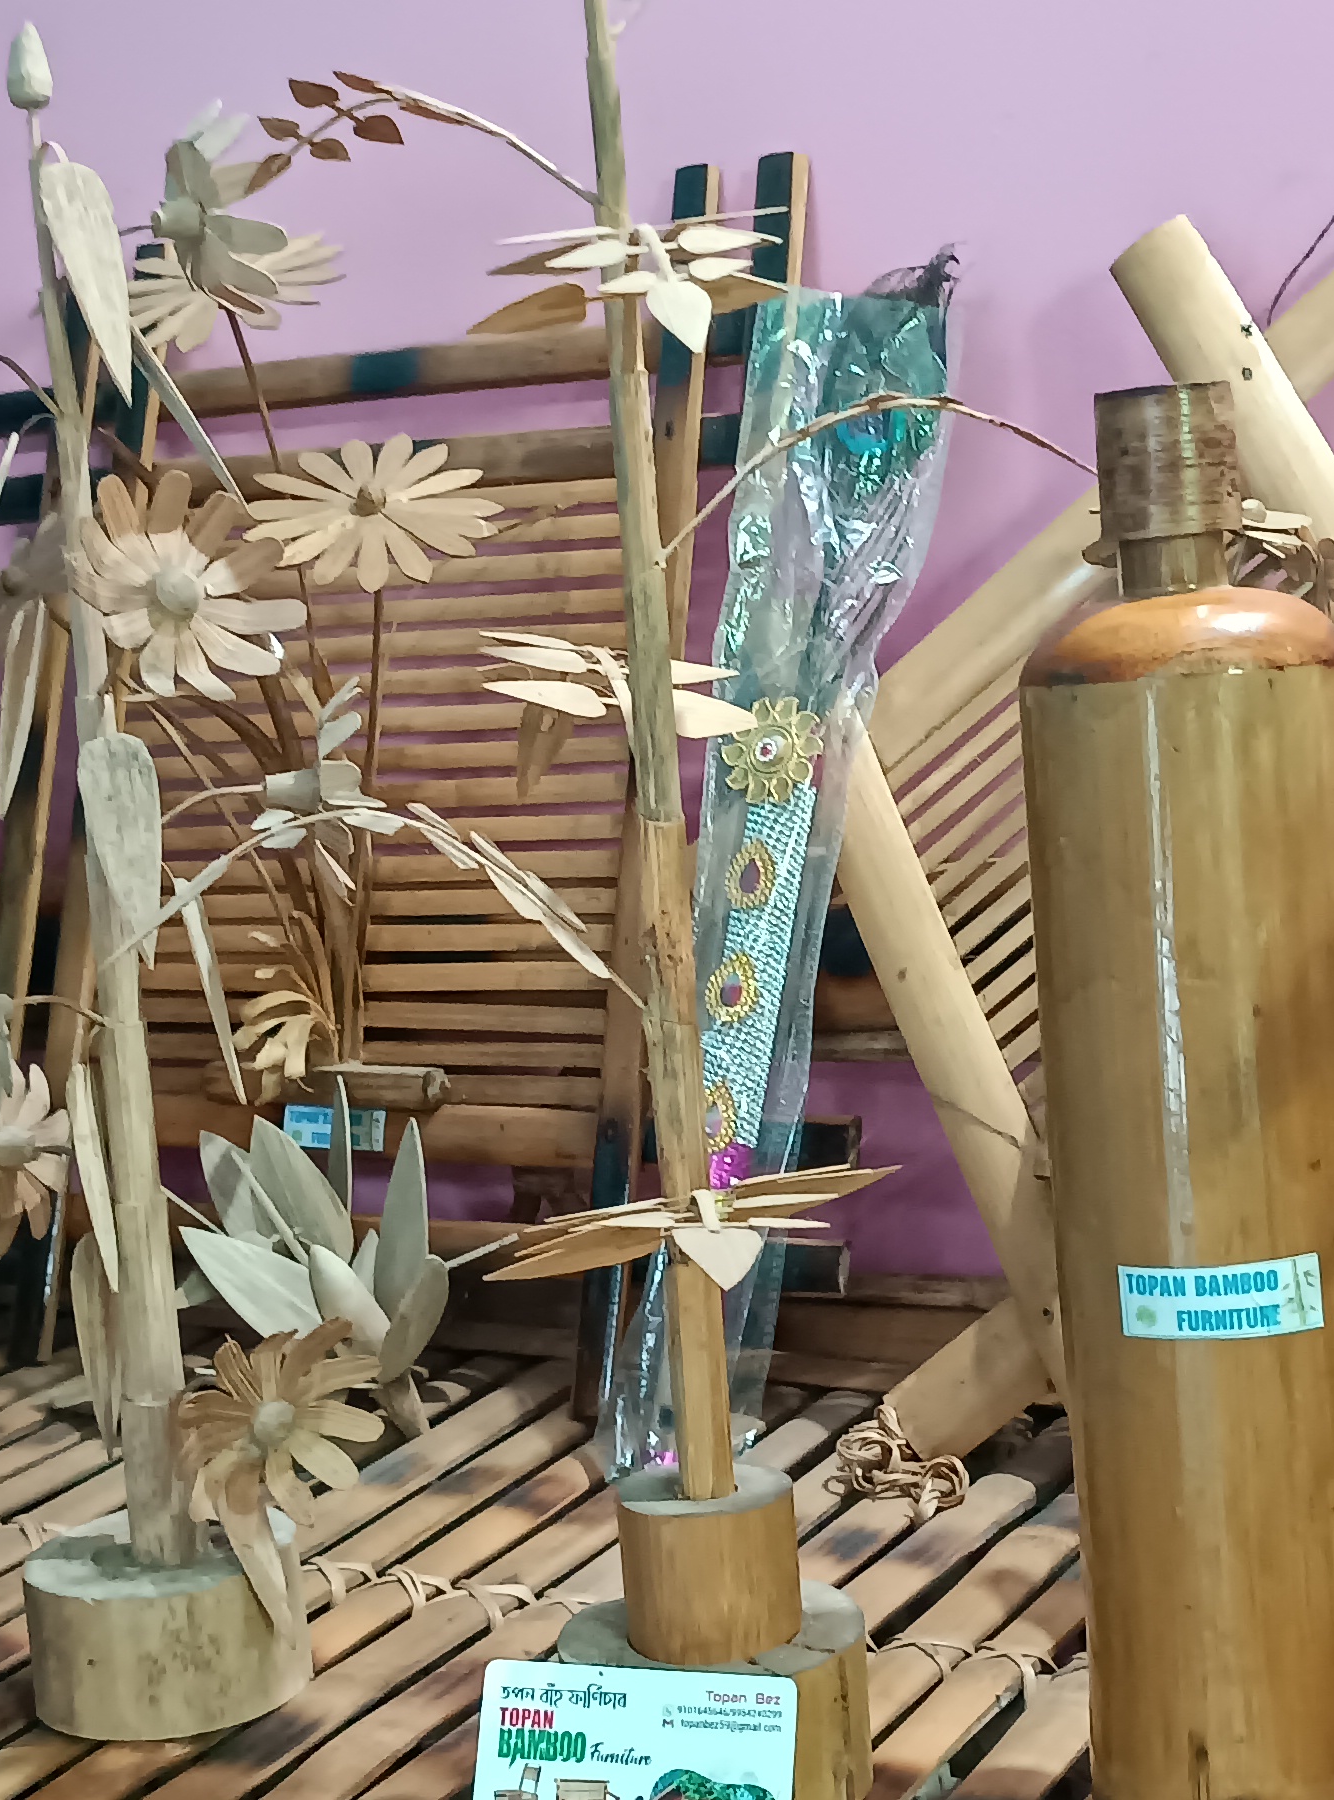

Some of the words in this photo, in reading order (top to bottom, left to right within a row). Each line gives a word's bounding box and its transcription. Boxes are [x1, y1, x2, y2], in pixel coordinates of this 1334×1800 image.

[1126, 1273, 1186, 1297] TOPAN
[1194, 1269, 1279, 1297] BAMBOO
[1176, 1304, 1281, 1332] FURNITURE
[706, 1691, 747, 1705] Topan
[756, 1693, 781, 1705] Bez
[499, 1707, 554, 1729] TOPAN
[498, 1728, 586, 1768] BAMBOO
[590, 1742, 652, 1765] Furniture
